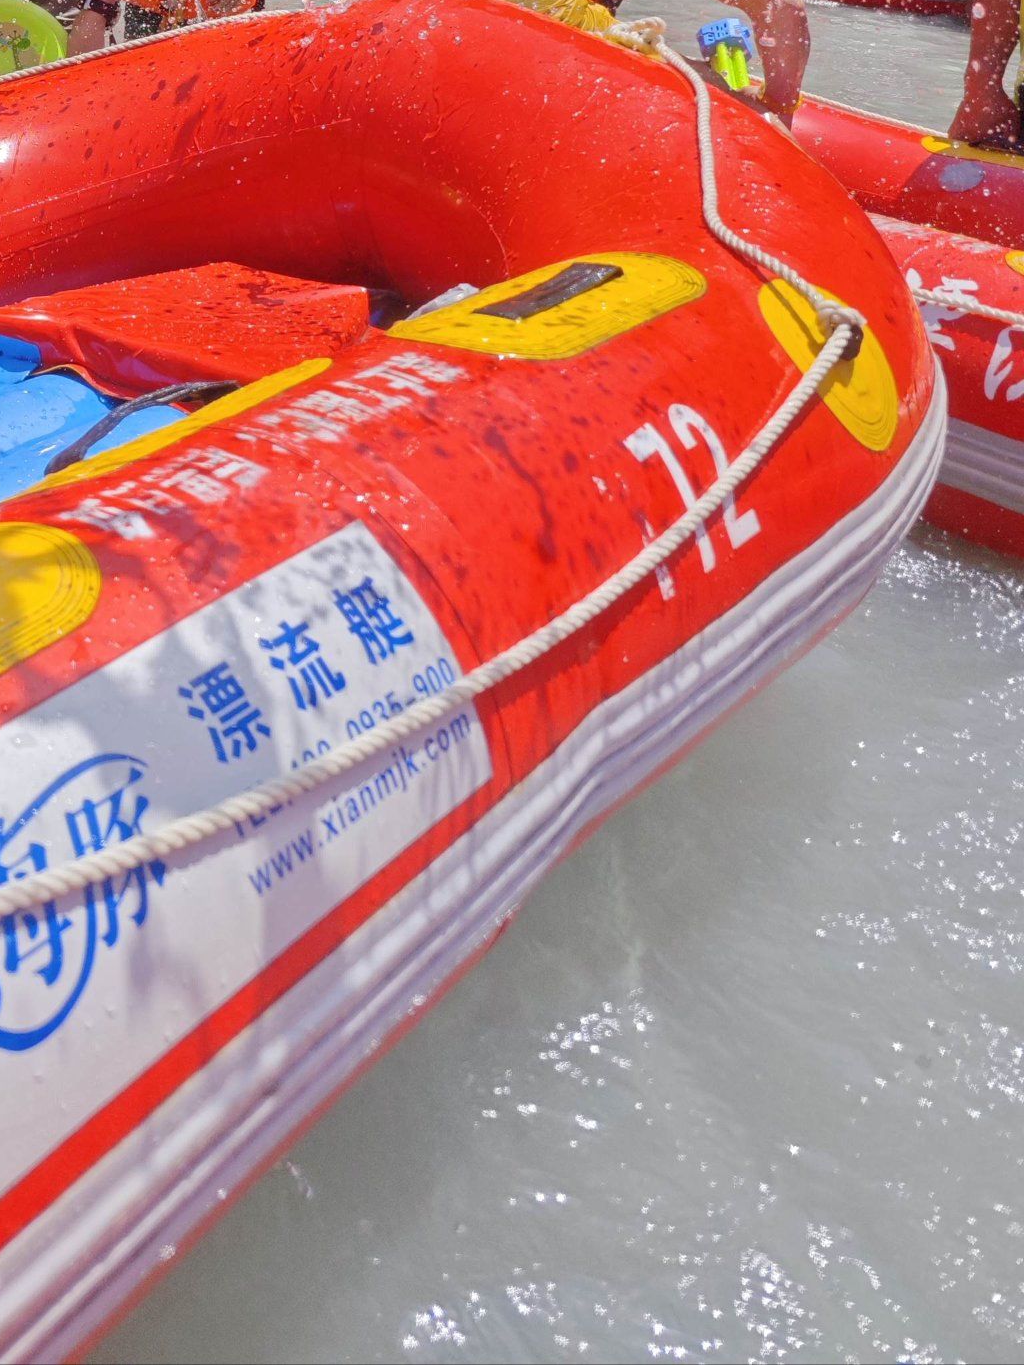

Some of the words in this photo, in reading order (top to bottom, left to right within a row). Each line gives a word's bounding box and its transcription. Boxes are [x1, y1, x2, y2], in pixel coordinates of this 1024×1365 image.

[178, 575, 414, 763] 漂流艇
[248, 712, 472, 896] www.xianmjk.com
